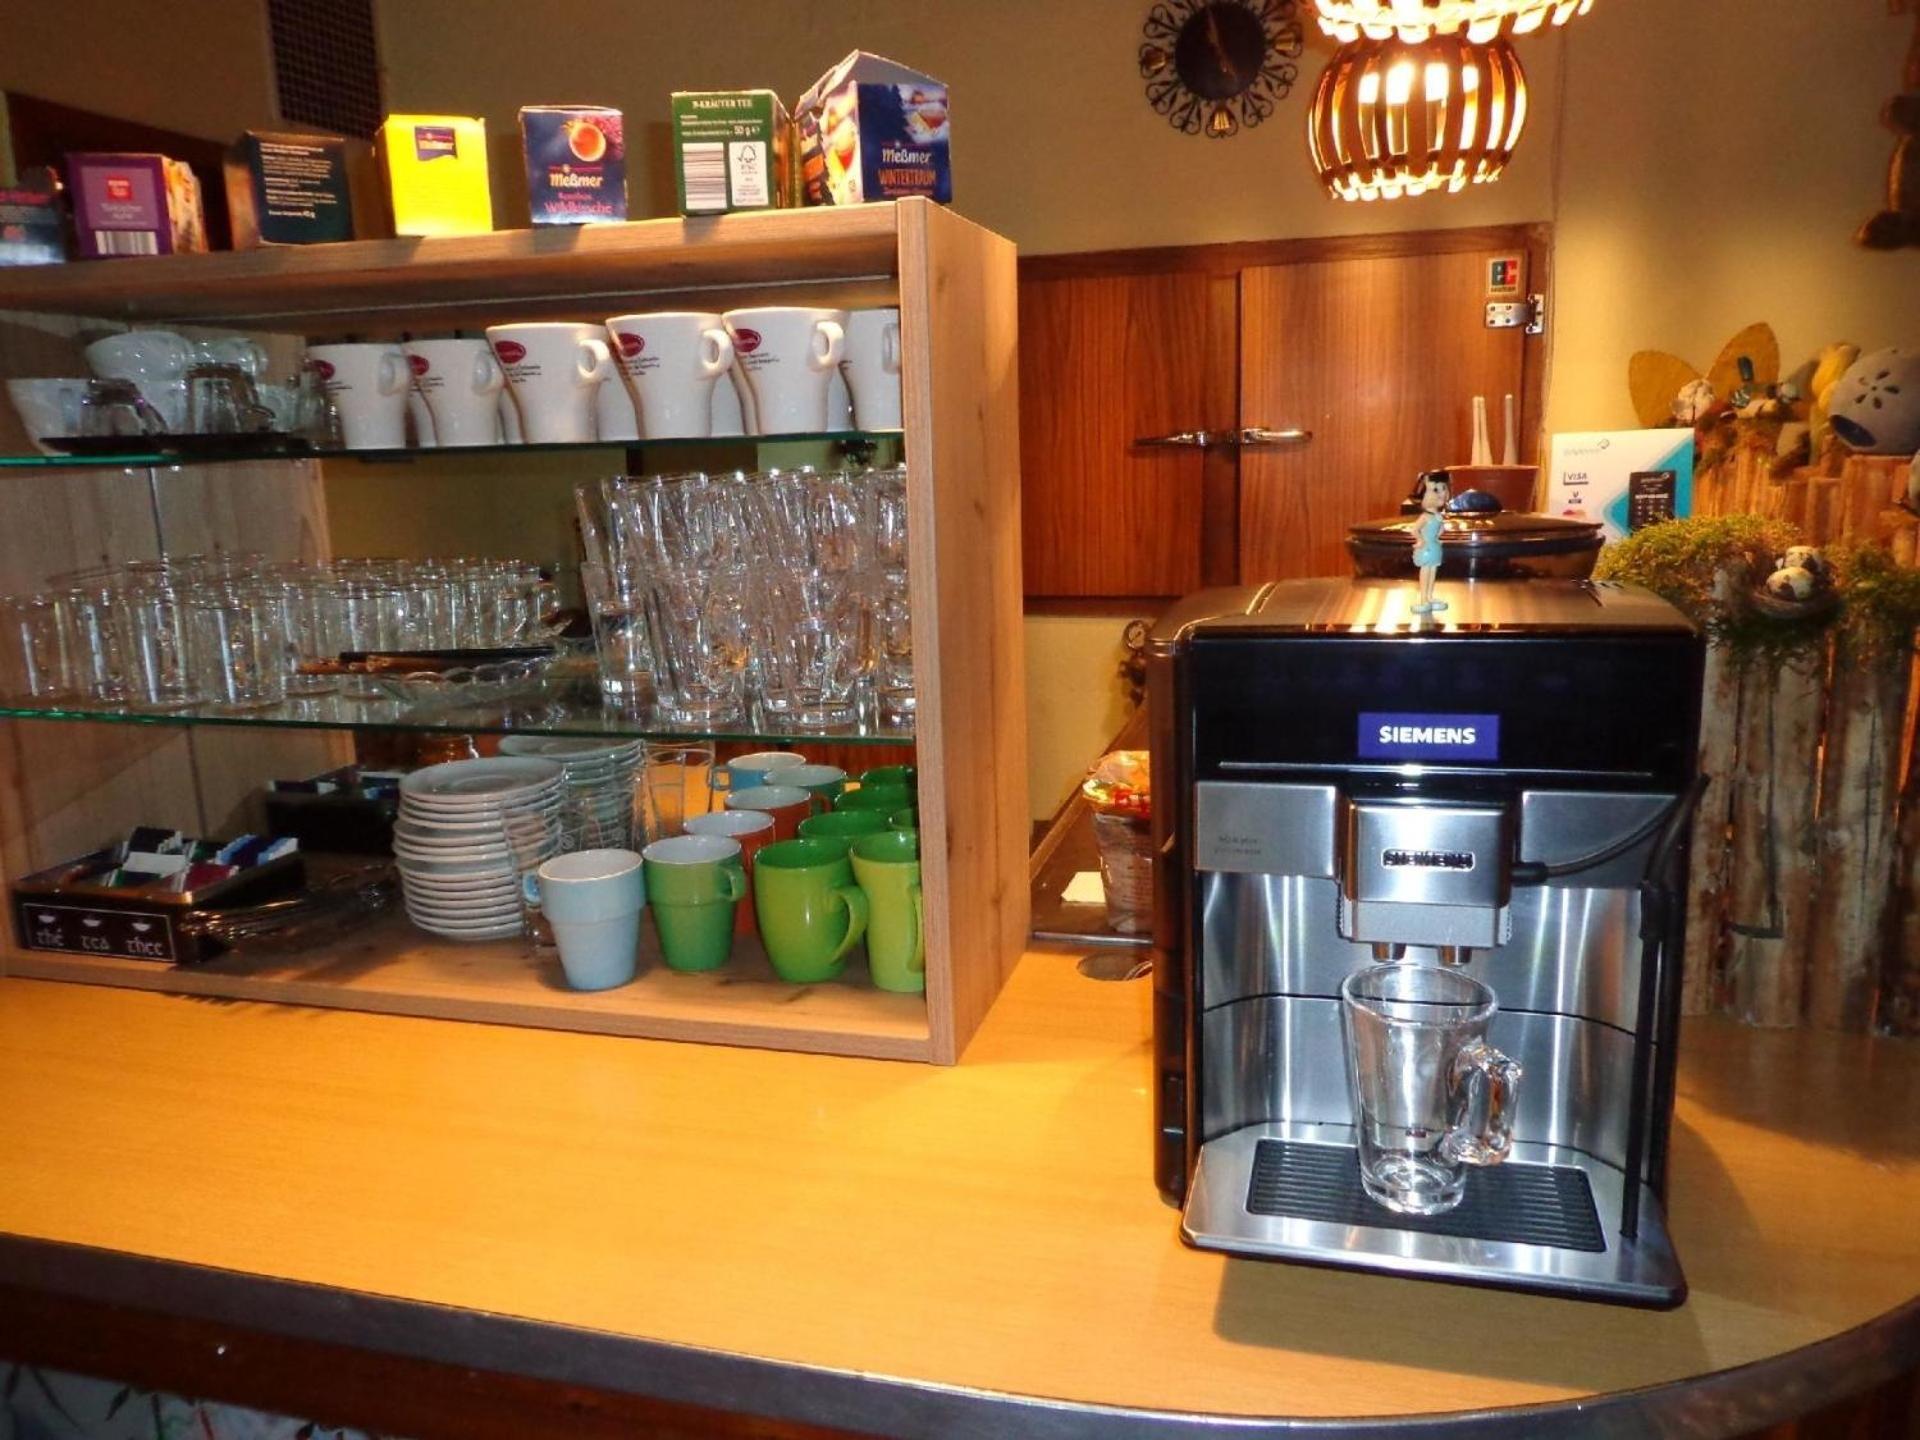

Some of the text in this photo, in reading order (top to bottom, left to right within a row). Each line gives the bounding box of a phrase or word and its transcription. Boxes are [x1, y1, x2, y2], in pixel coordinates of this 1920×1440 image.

[882, 148, 932, 164] Meßmer
[549, 173, 604, 188] Meßmer
[1379, 726, 1476, 744] SIEMENS
